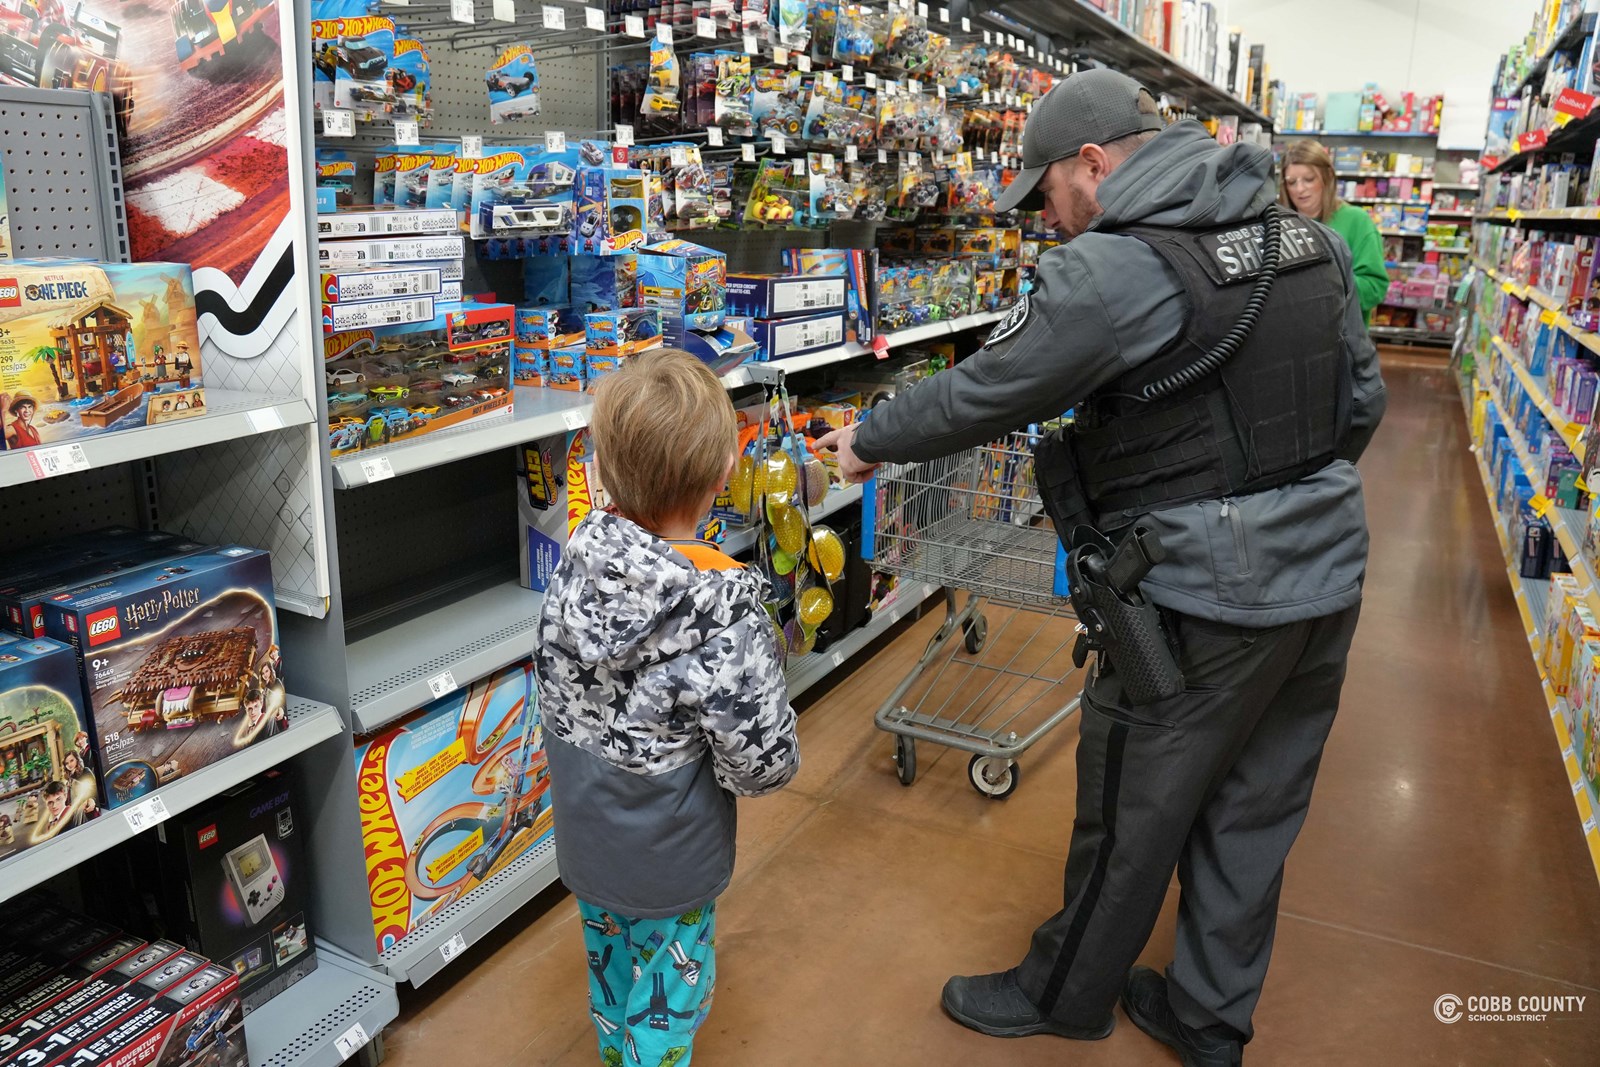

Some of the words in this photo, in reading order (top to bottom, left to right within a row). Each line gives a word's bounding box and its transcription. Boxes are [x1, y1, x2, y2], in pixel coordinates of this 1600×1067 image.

[1559, 95, 1587, 109] Rollback
[1217, 228, 1250, 244] COBB
[0, 287, 17, 298] EGO
[57, 281, 89, 299] PIECE
[124, 599, 162, 630] Harry
[161, 588, 200, 615] Potter
[90, 617, 117, 635] LEGO
[92, 658, 109, 671] 9+
[104, 732, 120, 744] 518
[105, 736, 135, 754] pcs/pzs
[250, 799, 275, 818] GAME
[274, 791, 290, 808] BOY
[200, 828, 217, 843] LEGO
[1, 1008, 18, 1018] DE
[19, 977, 71, 1008] AVENTURA
[36, 1009, 53, 1020] SET
[54, 1001, 67, 1010] DE
[66, 979, 104, 1002] REGALOS
[41, 1013, 58, 1024] DE
[58, 982, 110, 1014] AVENTURA
[62, 1023, 79, 1034] SET
[80, 1015, 93, 1023] DE
[92, 992, 130, 1016] REGALOS
[67, 1028, 84, 1038] DE
[84, 995, 135, 1028] AVENTURA
[88, 1038, 106, 1050] SET
[106, 1029, 120, 1039] DE
[120, 1006, 156, 1031] REGALOS
[94, 1043, 111, 1054] DE
[112, 1010, 162, 1044] AVENTURA
[17, 1048, 47, 1067] 3
[115, 1032, 162, 1067] ADVENTURE
[138, 1044, 156, 1061] SET
